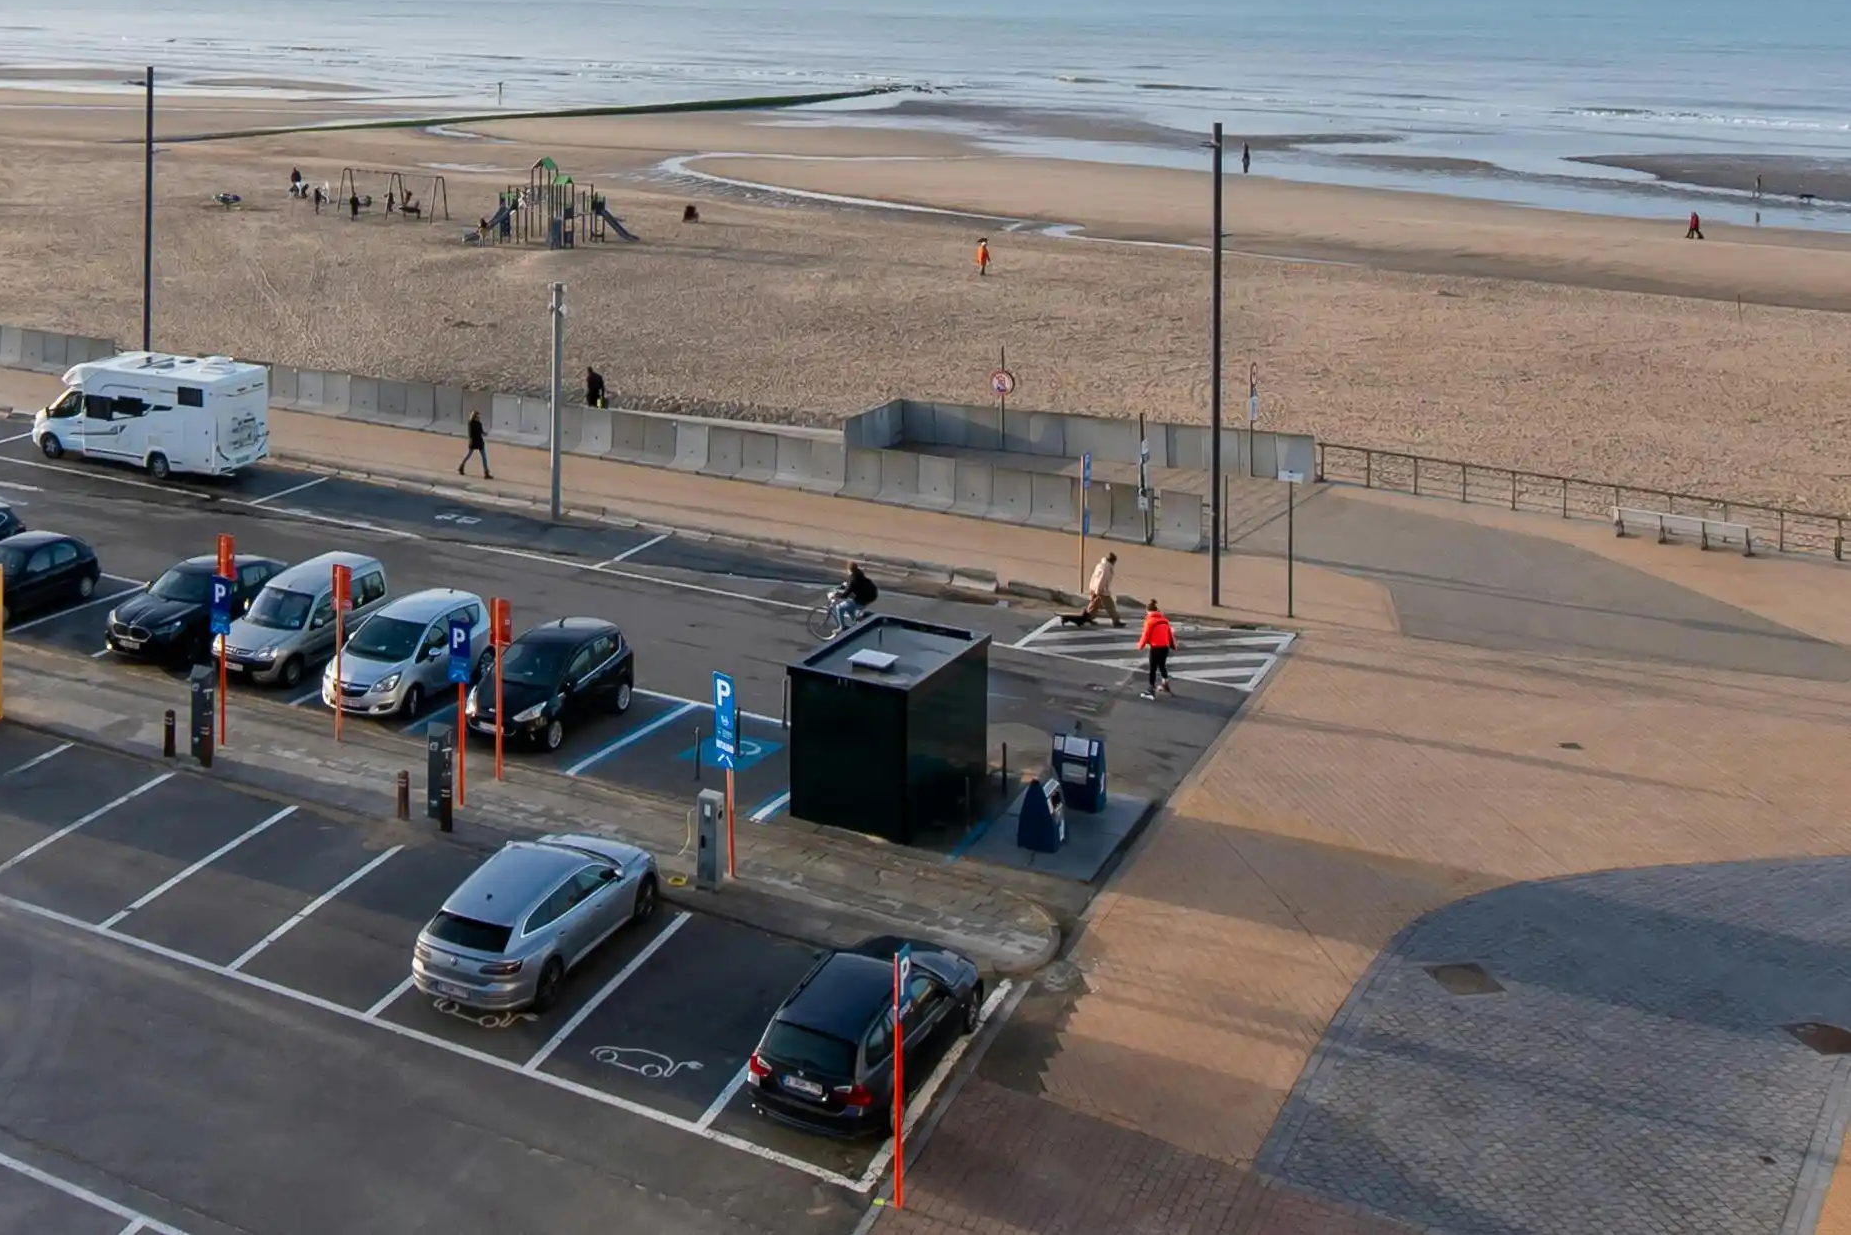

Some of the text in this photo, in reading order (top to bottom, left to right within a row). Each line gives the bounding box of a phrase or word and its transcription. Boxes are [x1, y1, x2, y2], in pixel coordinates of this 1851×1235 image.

[214, 583, 227, 603] P
[452, 627, 466, 649] P
[716, 678, 731, 706] P
[900, 955, 910, 996] P
